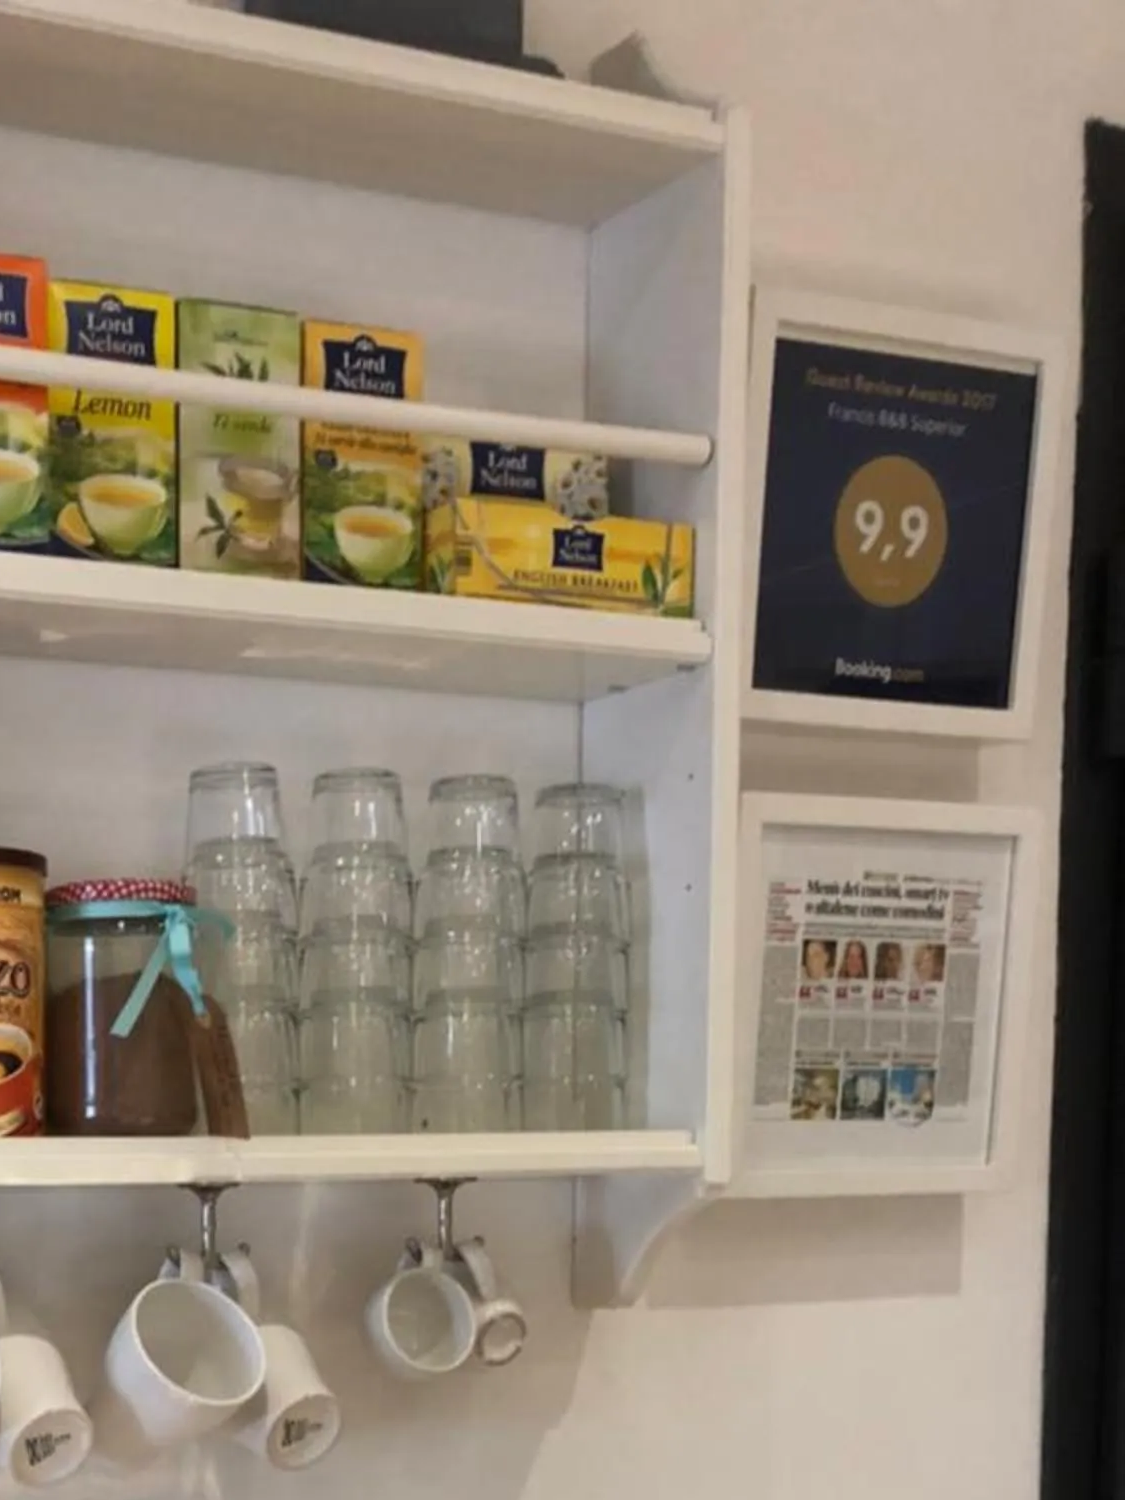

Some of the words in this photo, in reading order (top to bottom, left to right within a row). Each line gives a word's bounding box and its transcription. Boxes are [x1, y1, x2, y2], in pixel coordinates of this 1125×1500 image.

[87, 313, 134, 335] Lord
[78, 331, 146, 357] Nelson
[343, 351, 386, 373] Lord
[334, 369, 397, 394] Nelson
[73, 389, 152, 421] Lemon
[488, 451, 528, 471] Lord
[481, 468, 537, 490] Nelson
[855, 500, 929, 561] 9,9
[565, 535, 593, 550] Lord
[558, 547, 598, 565] Nelson
[513, 569, 567, 586] ENGLISH
[572, 574, 639, 592] BREAKFAST
